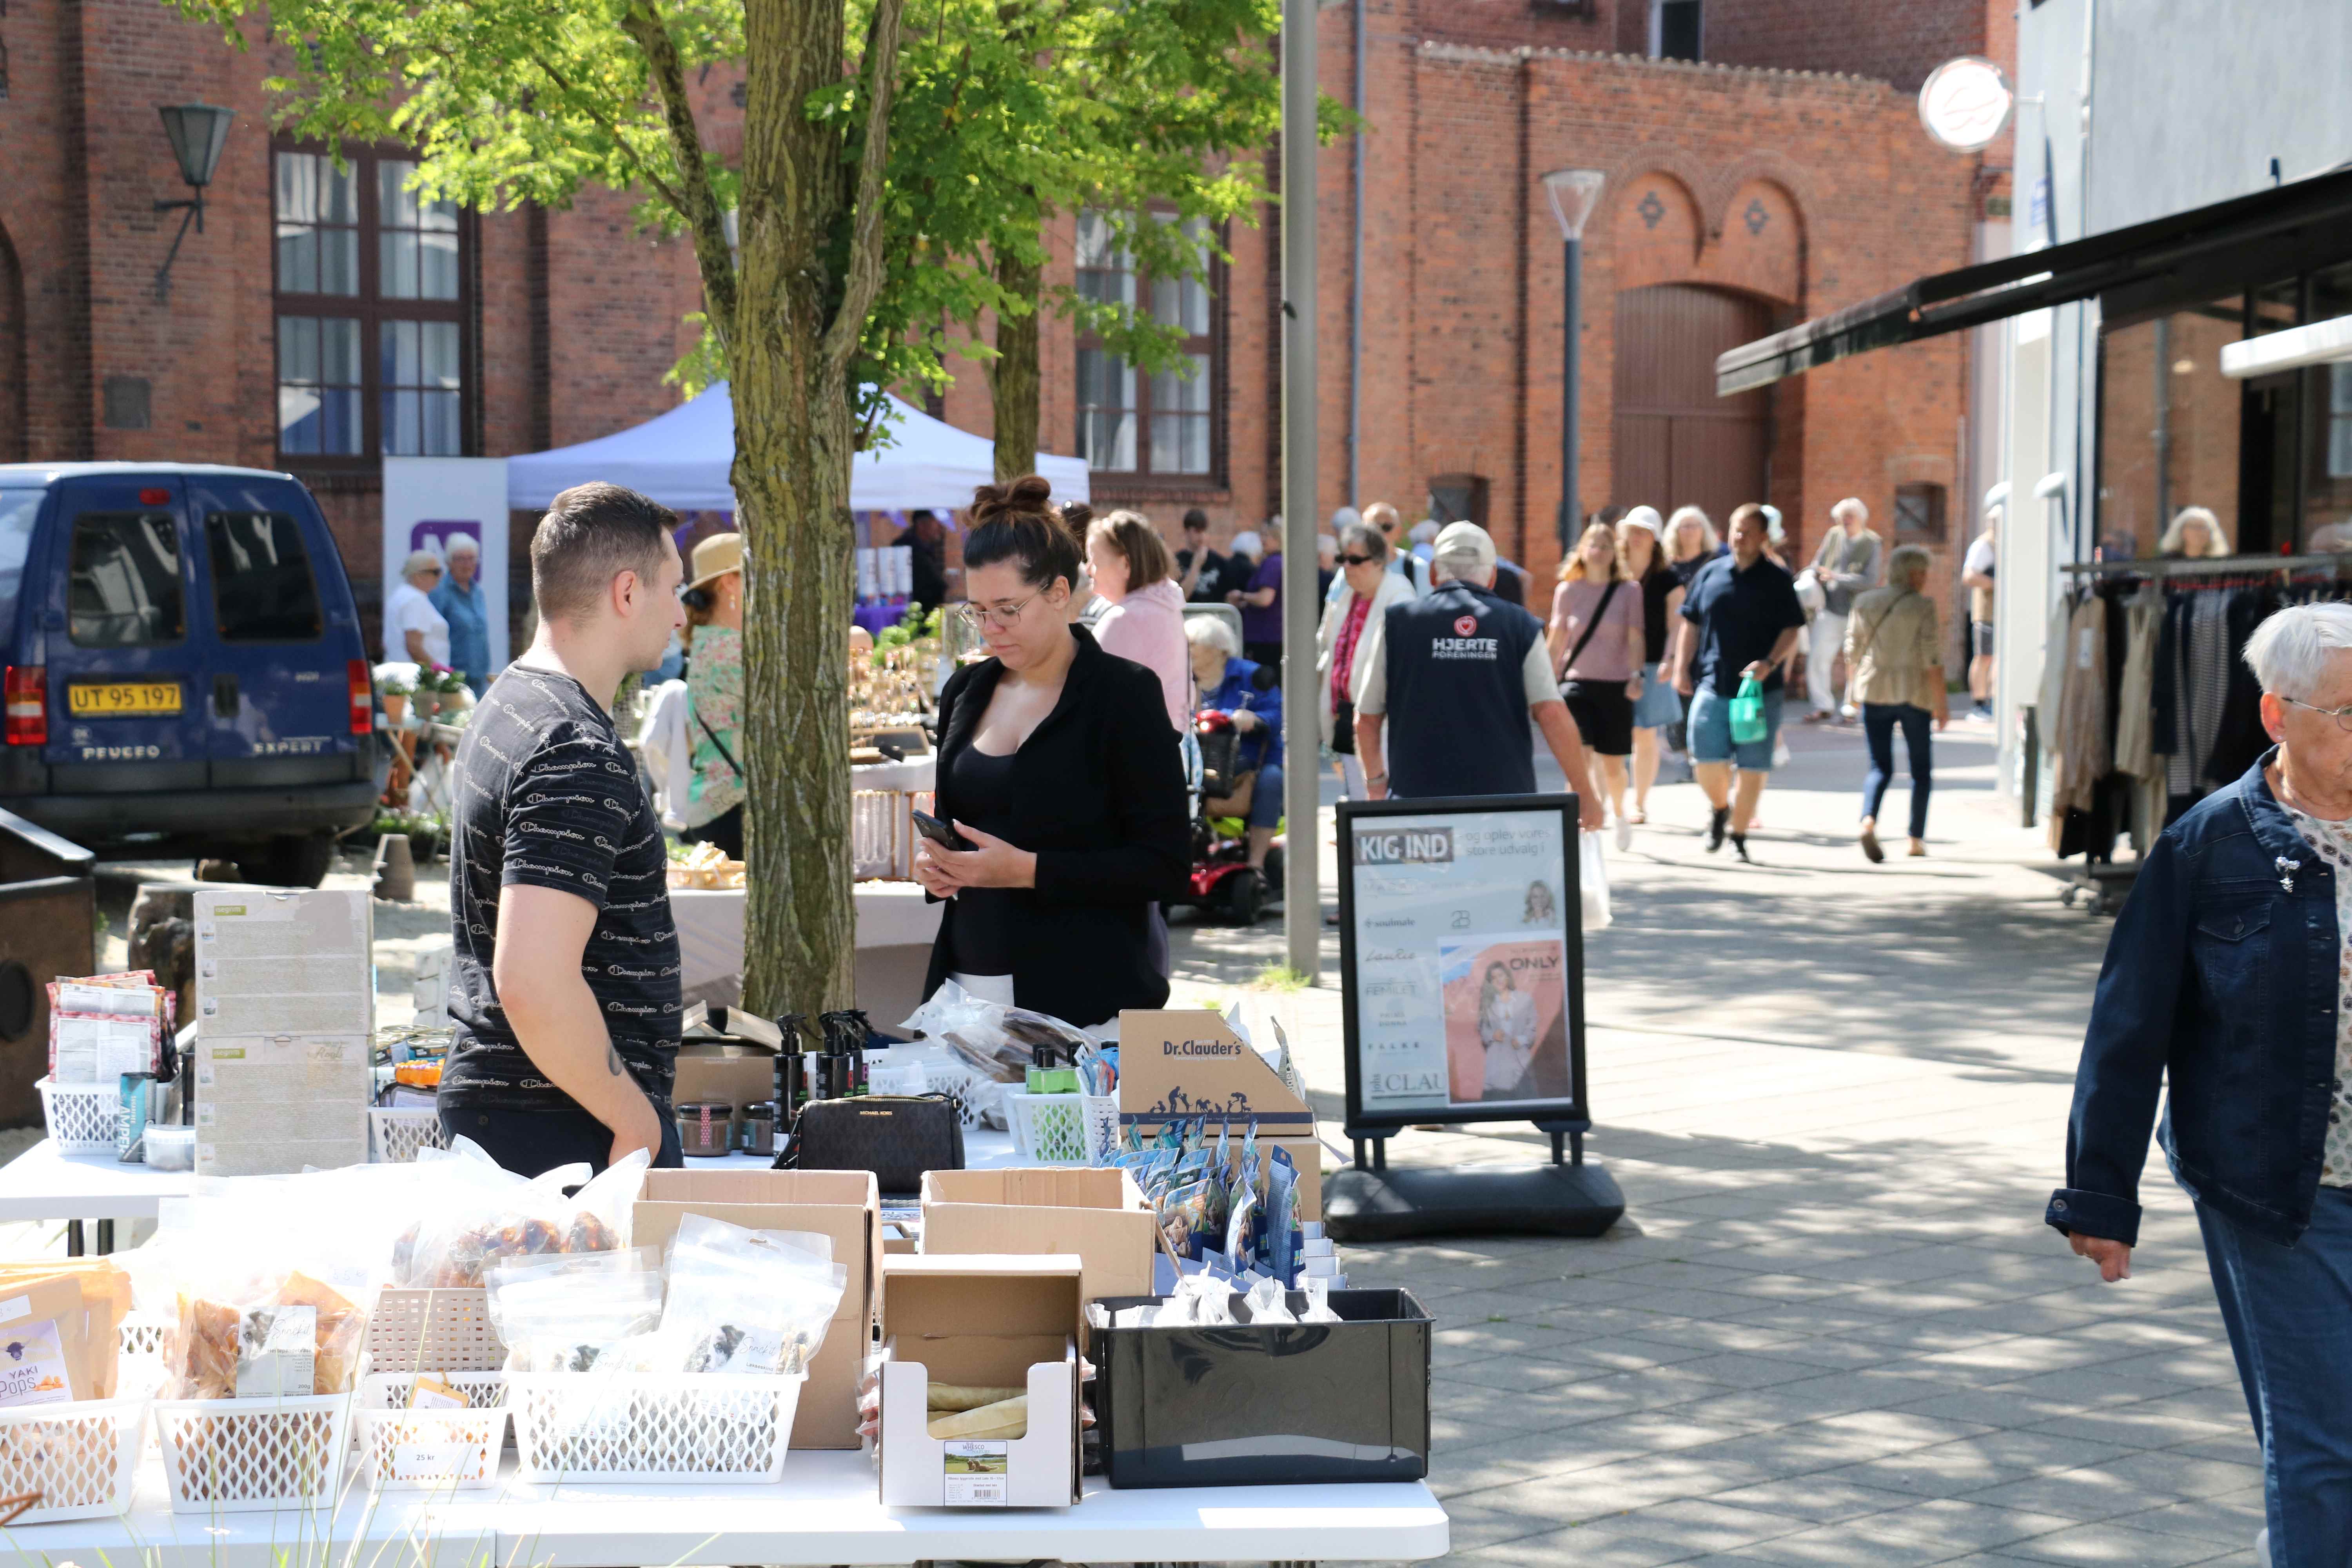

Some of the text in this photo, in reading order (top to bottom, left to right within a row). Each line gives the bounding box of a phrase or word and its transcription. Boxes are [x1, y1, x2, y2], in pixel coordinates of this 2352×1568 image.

[1432, 637, 1498, 651] HJERTE
[1432, 650, 1497, 660] FORENINGEN
[75, 687, 176, 707] UT 95 197
[532, 679, 570, 715] Champion
[530, 761, 597, 773] Champion
[526, 793, 595, 804] Champion
[520, 822, 585, 840] Champion
[1466, 829, 1551, 843] og oplev vores
[1360, 833, 1448, 861] KIG IND
[1467, 844, 1496, 856] store
[1500, 842, 1538, 856] udvalg
[511, 858, 574, 877] Champion
[1510, 955, 1559, 970] ONLY
[608, 964, 656, 980] Champion
[1366, 985, 1418, 996] FEMILET
[608, 1002, 657, 1016] Champion
[452, 1074, 509, 1088] Champion
[9, 1365, 38, 1379] YAKI
[746, 1361, 774, 1372] Lakseskind
[0, 1377, 36, 1398] Pops
[962, 1442, 985, 1450] WHESCO
